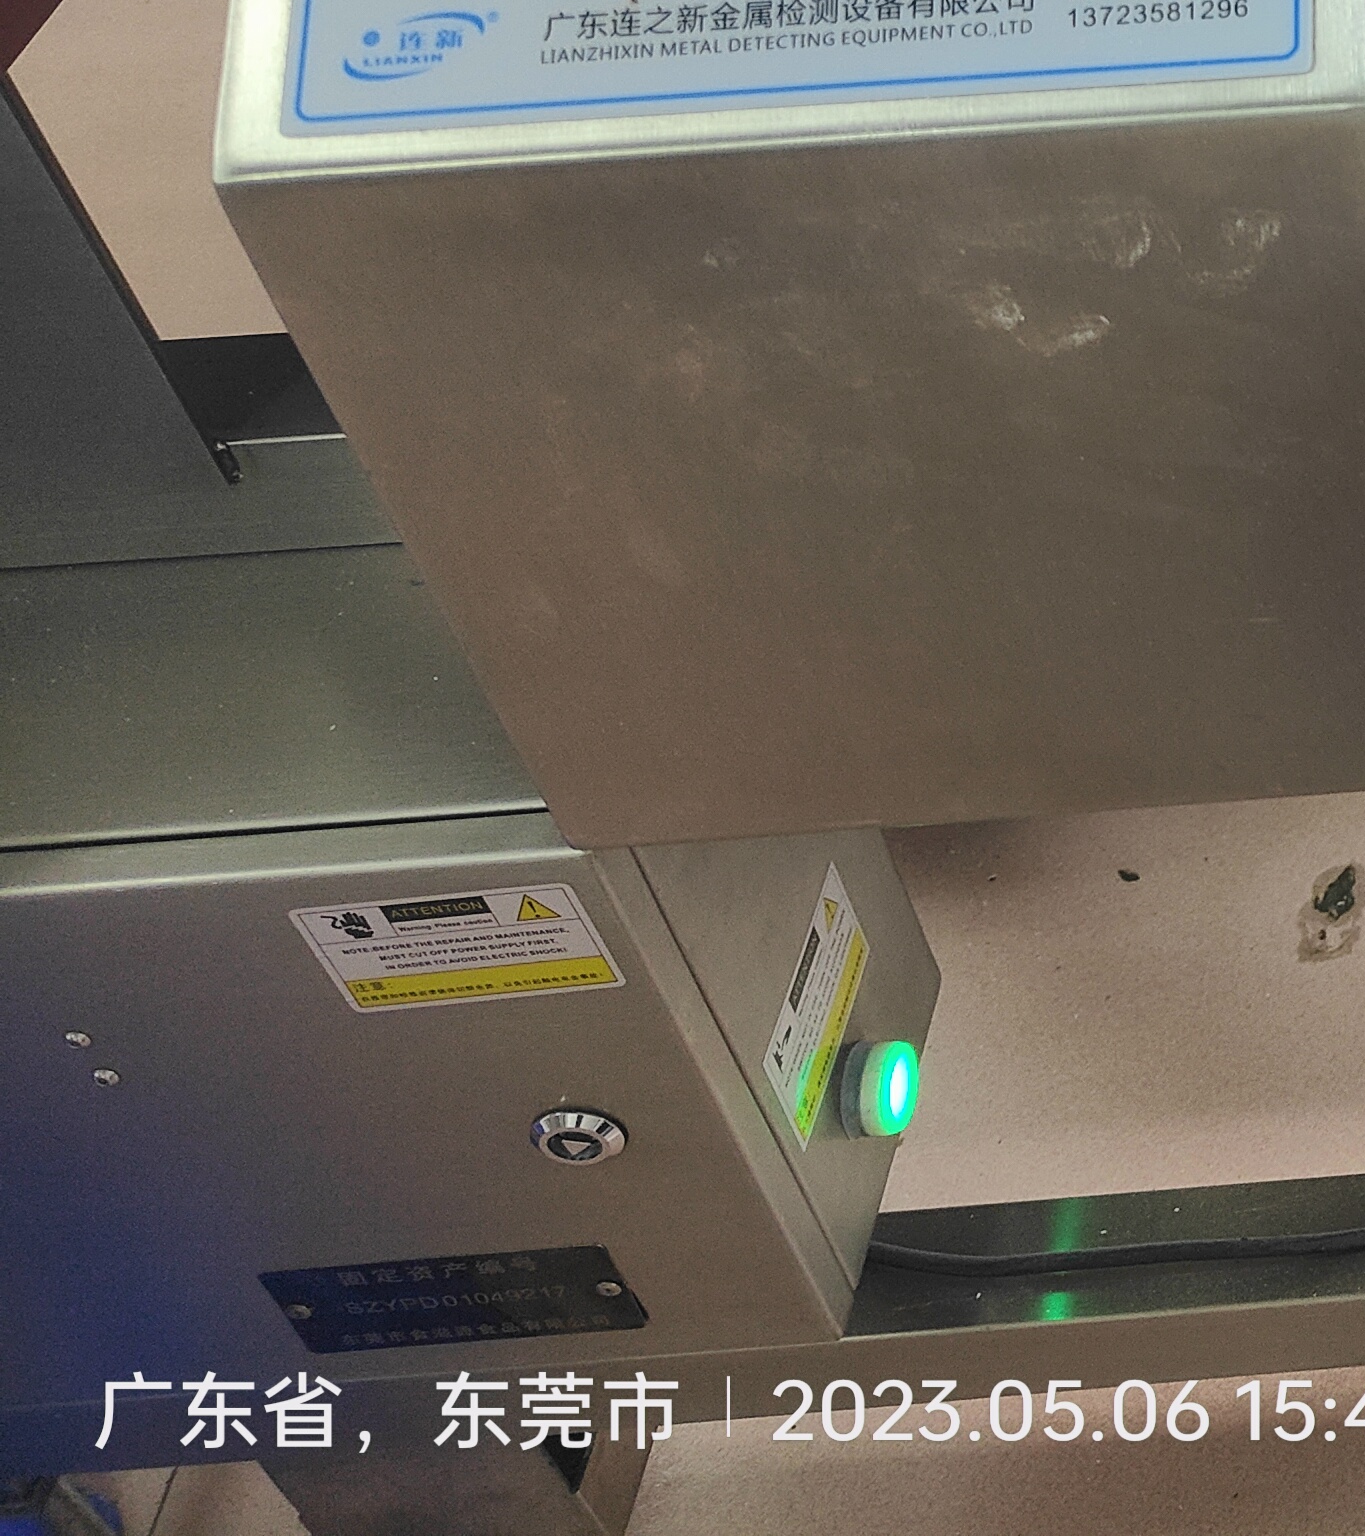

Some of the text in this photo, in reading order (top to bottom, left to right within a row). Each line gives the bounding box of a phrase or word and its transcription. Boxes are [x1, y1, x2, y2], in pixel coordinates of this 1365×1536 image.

[540, 19, 1034, 66] LIANZHIXIN METAL DETECTING EQUIPMENT CO.,LTD
[363, 53, 443, 68] LIANXIN
[391, 901, 483, 919] ATTENTION
[415, 940, 434, 948] THE
[436, 936, 471, 946] REPAIR
[473, 934, 494, 942] AND
[379, 953, 406, 962] MUST
[408, 951, 428, 959] CUT
[430, 948, 449, 956] OFF
[451, 945, 487, 954] POWER
[489, 942, 526, 951] SUPPLY
[397, 961, 433, 969] ORDER
[448, 955, 478, 964] AVOID
[480, 951, 528, 961] ELECTRIC
[337, 1255, 538, 1288] 固定资产编号
